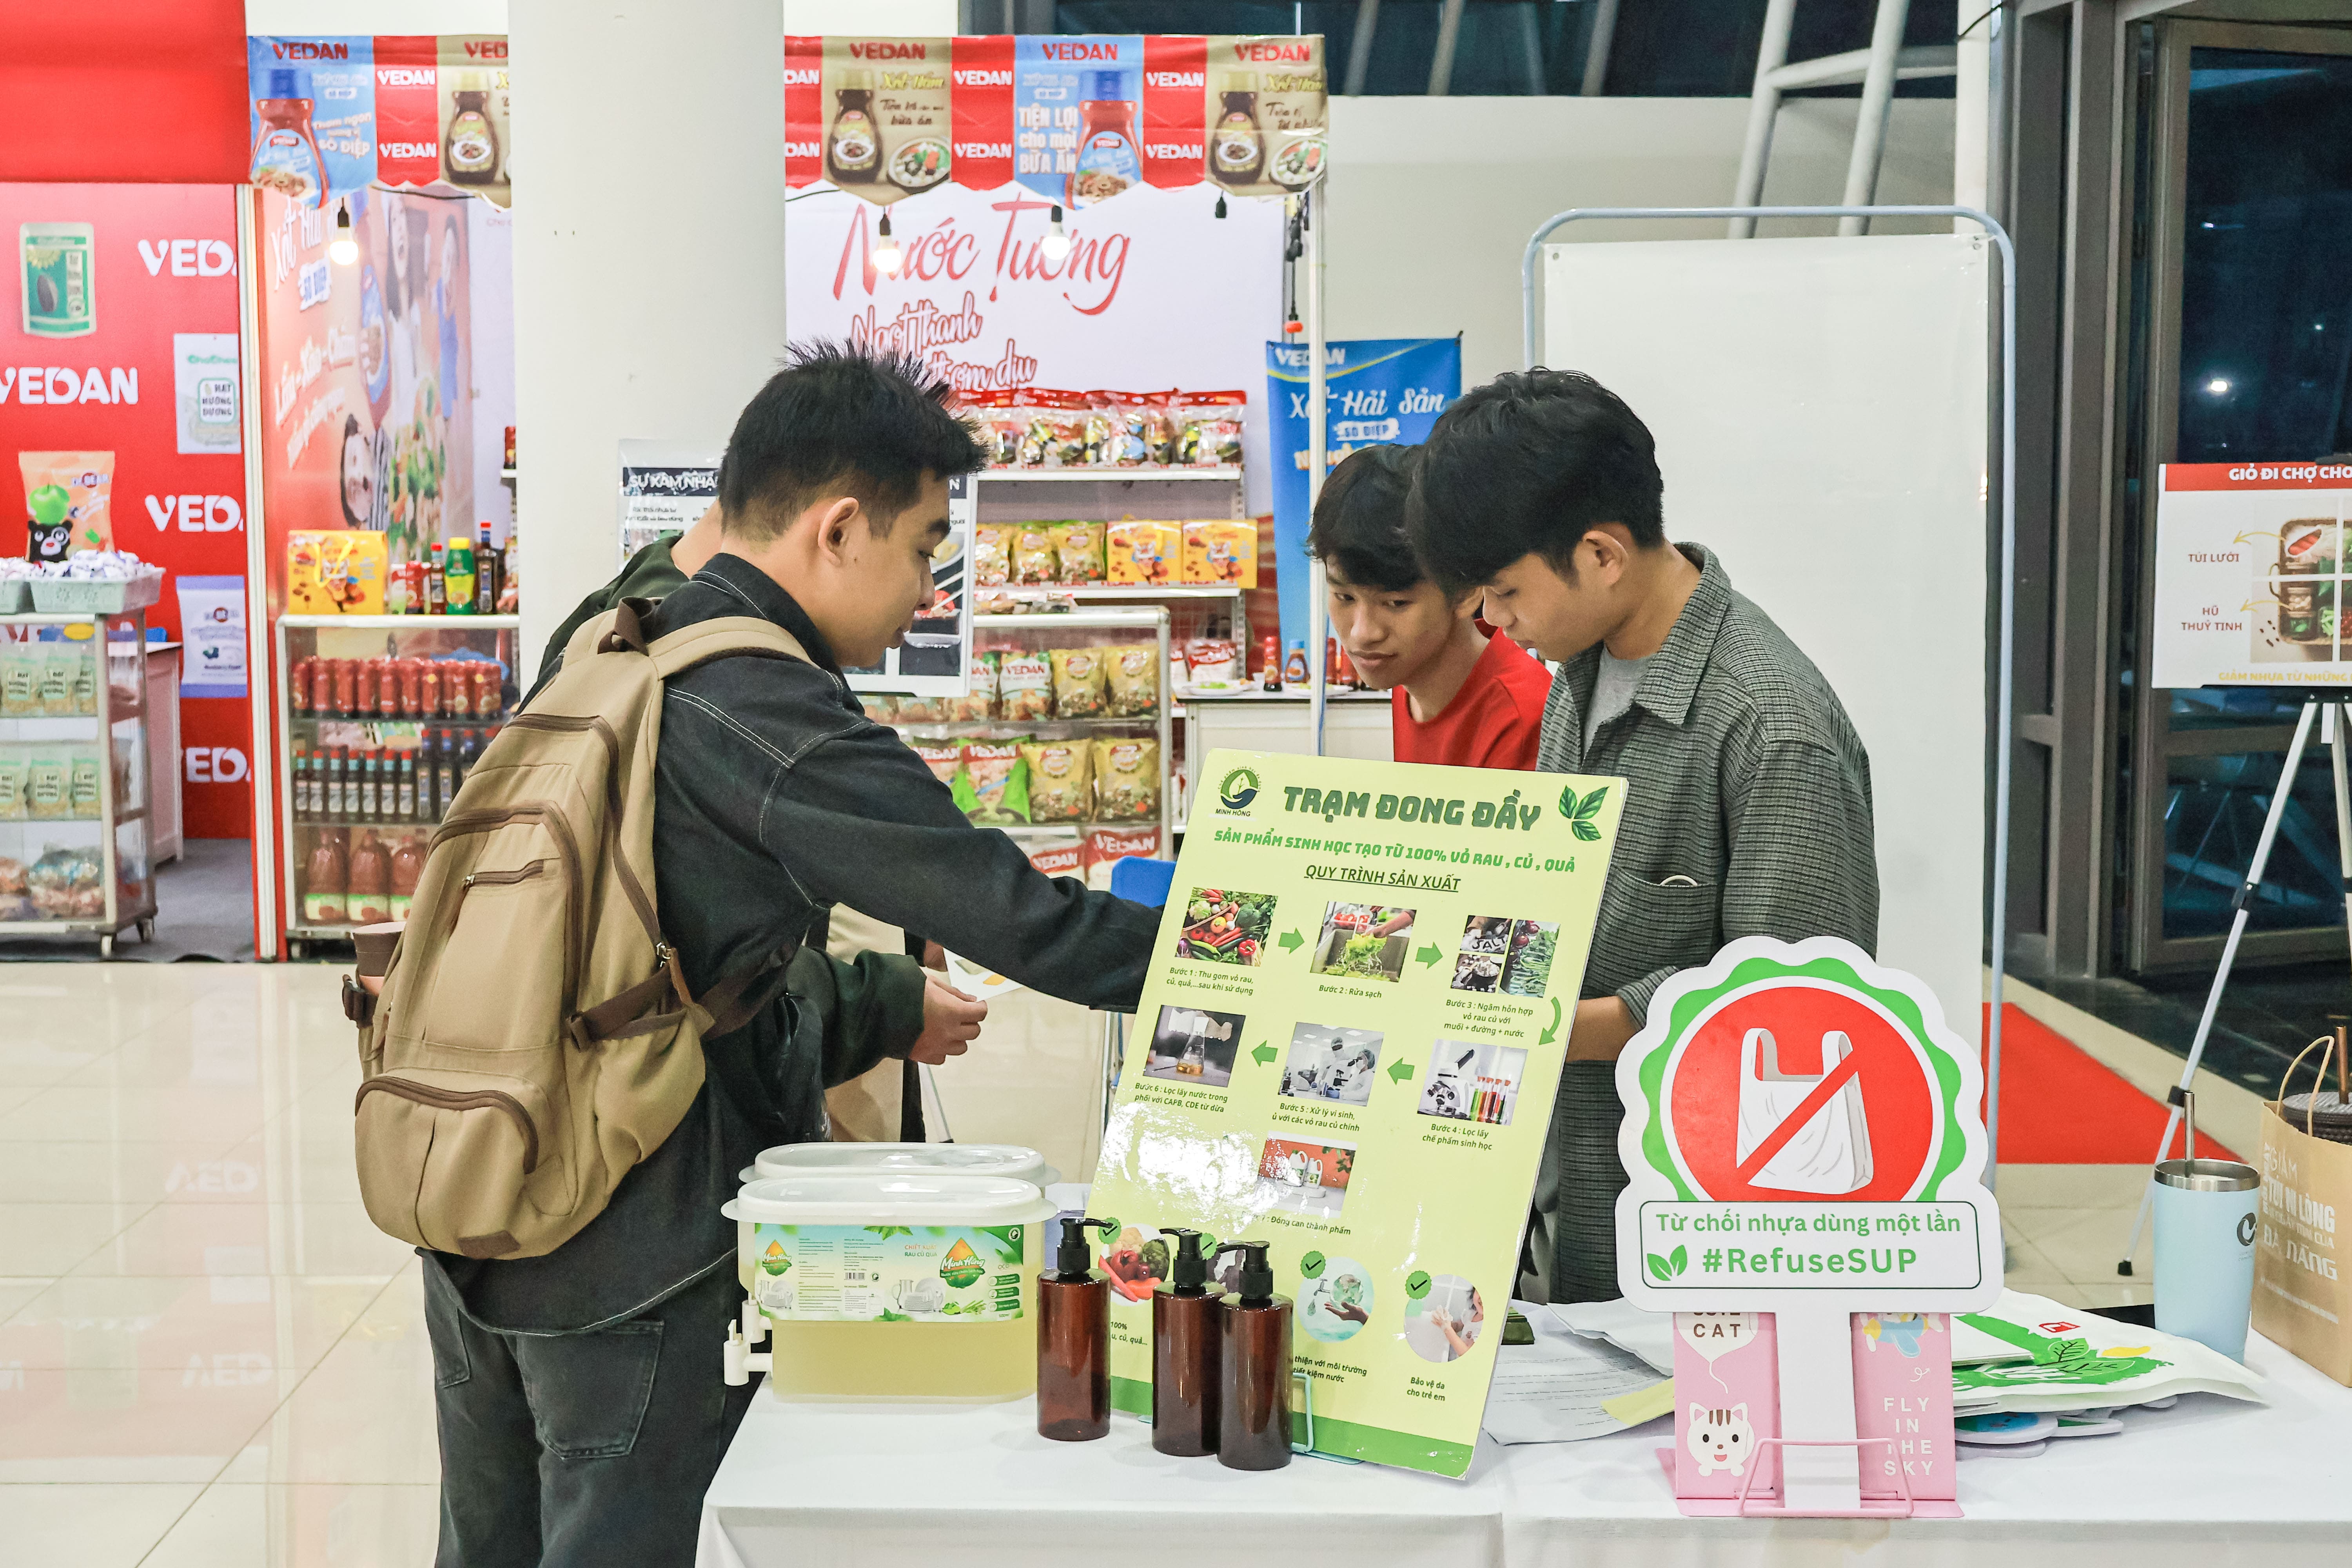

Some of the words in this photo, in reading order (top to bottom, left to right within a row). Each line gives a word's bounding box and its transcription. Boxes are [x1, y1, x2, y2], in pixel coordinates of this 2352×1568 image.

[272, 42, 348, 60] VEDAN
[465, 41, 508, 58] VED
[850, 43, 925, 59] VEDAN
[1043, 44, 1118, 61] VEDAN
[1234, 44, 1310, 61] VEDAN
[377, 70, 435, 86] VEDAN
[953, 71, 1012, 86] VEDAN
[1146, 72, 1203, 87] VEDAN
[1018, 103, 1050, 131] TIỆN
[1055, 105, 1078, 131] LỢI
[1019, 131, 1047, 149] cho
[380, 142, 437, 158] VEDAN
[954, 143, 1011, 158] VEDAN
[1145, 145, 1203, 160] VEDAN
[1019, 149, 1051, 174] BỮA
[1055, 148, 1076, 174] ĂN
[137, 239, 237, 277] VED
[1341, 389, 1388, 416] Hải
[1398, 387, 1446, 415] Sản
[2229, 463, 2258, 481] GIỎ
[2260, 467, 2278, 480] ĐI
[2281, 466, 2317, 483] CHỢ
[145, 494, 243, 532] VED
[2188, 553, 2207, 563] TÚI
[2210, 551, 2239, 563] LƯỚI
[2202, 605, 2219, 616] HŨ
[2215, 622, 2242, 631] TINH
[1007, 665, 1045, 675] VEDAN
[2218, 671, 2248, 681] GIẢM
[2249, 672, 2285, 683] NHỰA
[2286, 670, 2303, 681] TỪ
[2304, 670, 2347, 681] NHỮNG
[969, 745, 1016, 757] VEDAN
[1283, 786, 1371, 823] TRẠM
[1375, 794, 1465, 826] ĐONG
[1471, 789, 1542, 831] ĐẦY
[1095, 834, 1156, 853] VEDAN
[1214, 827, 1242, 843] SẢN
[1243, 828, 1283, 847] PHẨM
[1285, 837, 1321, 850] SINH
[1323, 840, 1352, 856] HỌC
[1355, 843, 1382, 858] TẠO
[1385, 843, 1405, 858] TỪ
[1405, 848, 1446, 862] 100%
[1450, 848, 1470, 864] VỎ
[1472, 853, 1504, 866] RAU
[1514, 853, 1534, 869] CỦ
[1544, 856, 1575, 873] QUẢ
[1034, 853, 1078, 869] VEDAN
[1305, 864, 1335, 879] QUY
[1340, 866, 1385, 884] TRÌNH
[1388, 869, 1416, 887] SẢN
[1421, 873, 1461, 890] XUẤT
[1169, 967, 1188, 975] Bước
[1166, 977, 1176, 985] củ,
[1235, 986, 1254, 996] dụng
[1319, 985, 1338, 993] Bước
[1446, 999, 1466, 1008] Bước
[1477, 1003, 1500, 1012] Ngâm
[1502, 1004, 1516, 1013] hỗn
[1518, 1007, 1533, 1017] hợp
[1471, 1025, 1496, 1036] đường
[1504, 1029, 1524, 1038] nước
[1135, 1082, 1153, 1091] Bước
[1163, 1087, 1176, 1095] Lọc
[1177, 1088, 1188, 1098] lấy
[1209, 1093, 1228, 1103] trong
[1134, 1094, 1151, 1102] phối
[1164, 1098, 1183, 1107] CAPB,
[1185, 1101, 1200, 1109] CDE
[1210, 1104, 1224, 1112] dừa
[1279, 1103, 1299, 1112] Bước
[1322, 1108, 1329, 1118] lý
[1338, 1111, 1355, 1120] sinh,
[1339, 1122, 1359, 1132] chính
[1431, 1123, 1451, 1132] Bước
[1463, 1127, 1476, 1137] Lọc
[1477, 1129, 1489, 1139] lấy
[1422, 1134, 1437, 1142] chế
[1460, 1140, 1477, 1148] sinh
[1478, 1142, 1492, 1151] học
[1271, 1216, 1290, 1227] Đóng
[1306, 1222, 1328, 1232] thành
[1657, 1214, 1688, 1231] Từ
[1694, 1209, 1740, 1231] chối
[1749, 1214, 1807, 1236] nhựa
[1813, 1214, 1869, 1236] dùng
[1877, 1213, 1920, 1236] một
[1927, 1209, 1960, 1232] lần
[941, 1256, 964, 1270] Minh
[1703, 1247, 1916, 1273] #RefuseSUP
[1111, 1321, 1127, 1330] 100%
[1693, 1324, 1740, 1338] CAT
[1119, 1334, 1128, 1343] củ,
[1295, 1356, 1313, 1365] thiện
[1315, 1358, 1325, 1367] với
[1327, 1361, 1341, 1370] môi
[1342, 1365, 1367, 1377] trường
[1307, 1369, 1324, 1379] kiệm
[1326, 1374, 1345, 1383] nước
[1410, 1377, 1424, 1386] Bảo
[1426, 1380, 1434, 1389] vệ
[1406, 1388, 1420, 1397] cho
[1421, 1391, 1432, 1399] trẻ
[1884, 1397, 1930, 1412] FLY
[1895, 1418, 1920, 1433] IN
[1884, 1460, 1933, 1477] SKY
